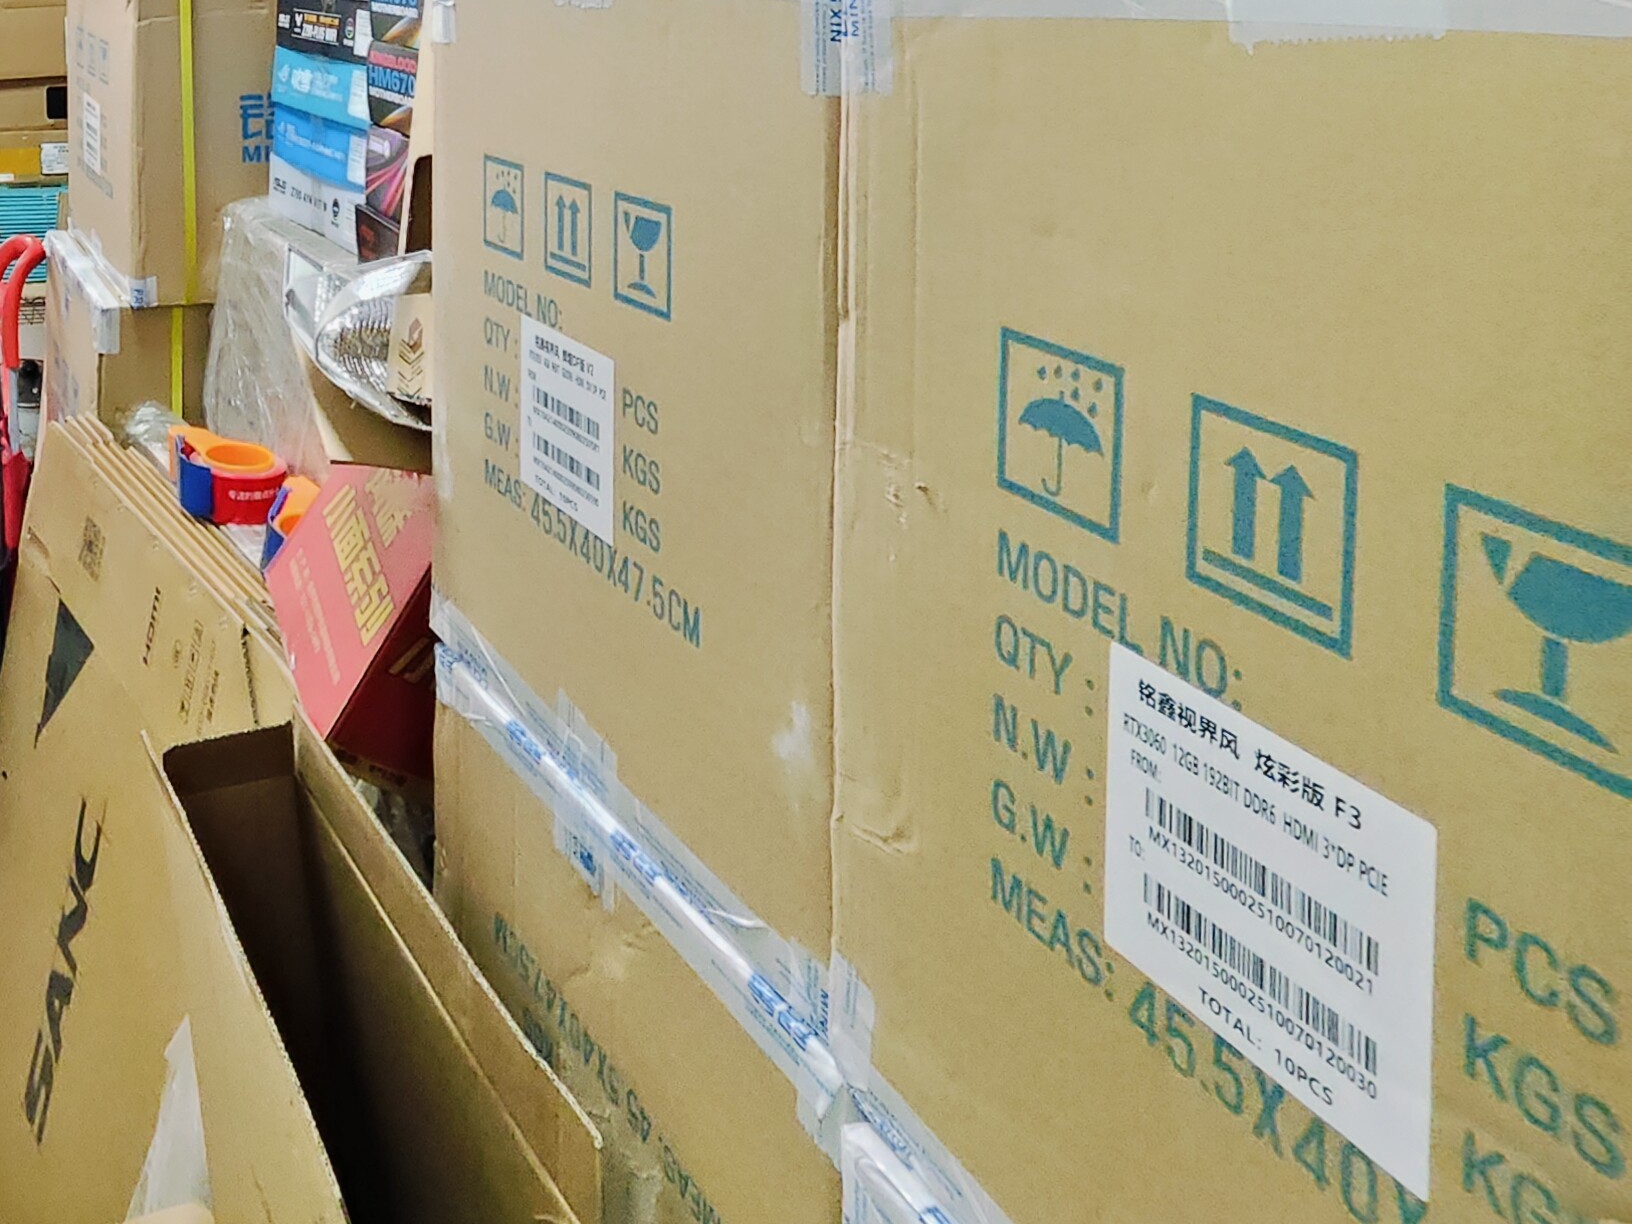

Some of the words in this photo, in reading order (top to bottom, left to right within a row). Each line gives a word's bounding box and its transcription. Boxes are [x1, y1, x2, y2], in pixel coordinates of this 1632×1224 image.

[829, 9, 843, 43] XIN
[368, 64, 416, 98] HM670
[483, 269, 532, 318] MODEL
[536, 293, 563, 332] NO:
[483, 316, 510, 352] QTY
[622, 387, 659, 436] PCS
[484, 458, 526, 512] MEAS:
[622, 444, 661, 495] KGS
[622, 500, 661, 553] KGS
[994, 614, 1073, 695] QTY
[996, 528, 1144, 657] MODEL
[1159, 615, 1243, 712] NO:
[993, 693, 1072, 785] N.W
[1138, 678, 1240, 760] 铭鑫视界风
[1254, 749, 1326, 812] 炫彩版
[1334, 797, 1363, 830] F3
[992, 778, 1070, 870] G.W
[1172, 743, 1200, 776] 12GB
[1203, 762, 1240, 802] 192BIT
[1243, 787, 1277, 825] DDR6
[1283, 813, 1319, 853] HDMI
[1359, 864, 1389, 897] PCIE
[990, 856, 1116, 1002] MEAS:
[1464, 896, 1621, 1045] PCS
[1198, 986, 1263, 1051] TOTAL:
[1273, 1048, 1334, 1106] 10PCS
[1464, 1012, 1626, 1180] KGS
